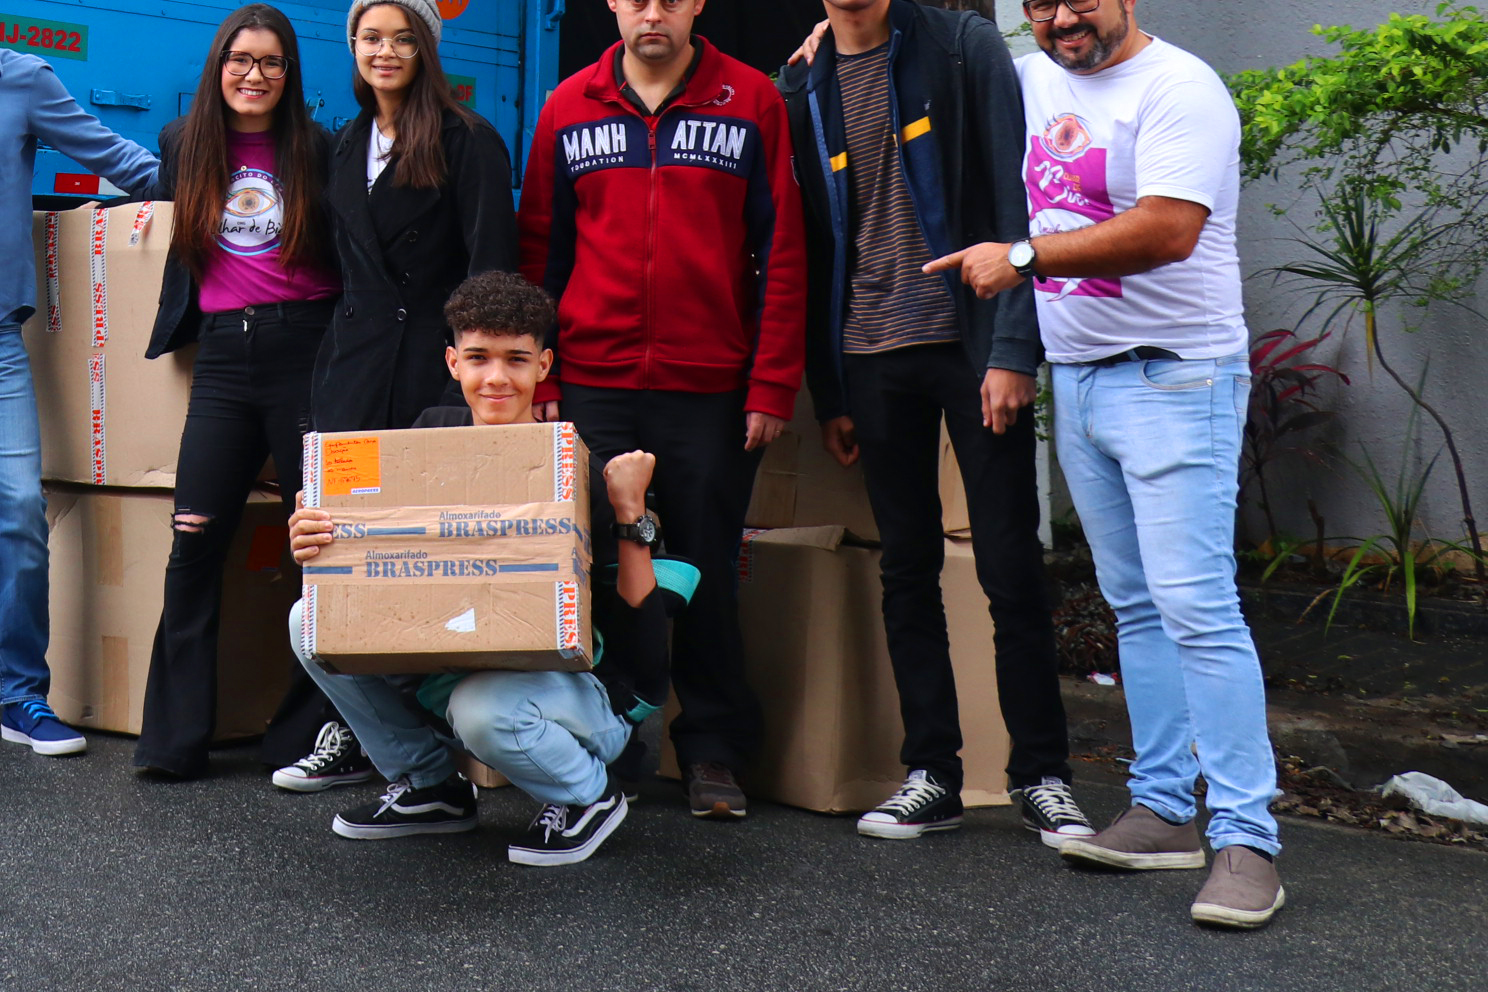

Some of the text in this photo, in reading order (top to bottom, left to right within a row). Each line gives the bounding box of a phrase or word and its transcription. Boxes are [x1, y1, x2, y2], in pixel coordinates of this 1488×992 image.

[562, 119, 747, 165] MANH ATTAN
[235, 172, 253, 180] CITO
[218, 218, 245, 234] lhar
[248, 218, 262, 234] de
[439, 510, 501, 521] Almoxarifado
[438, 516, 573, 538] BRASPRESS
[365, 549, 428, 561] Almoxarifado
[365, 559, 498, 578] BRASPRESS
[563, 581, 577, 650] PRES
